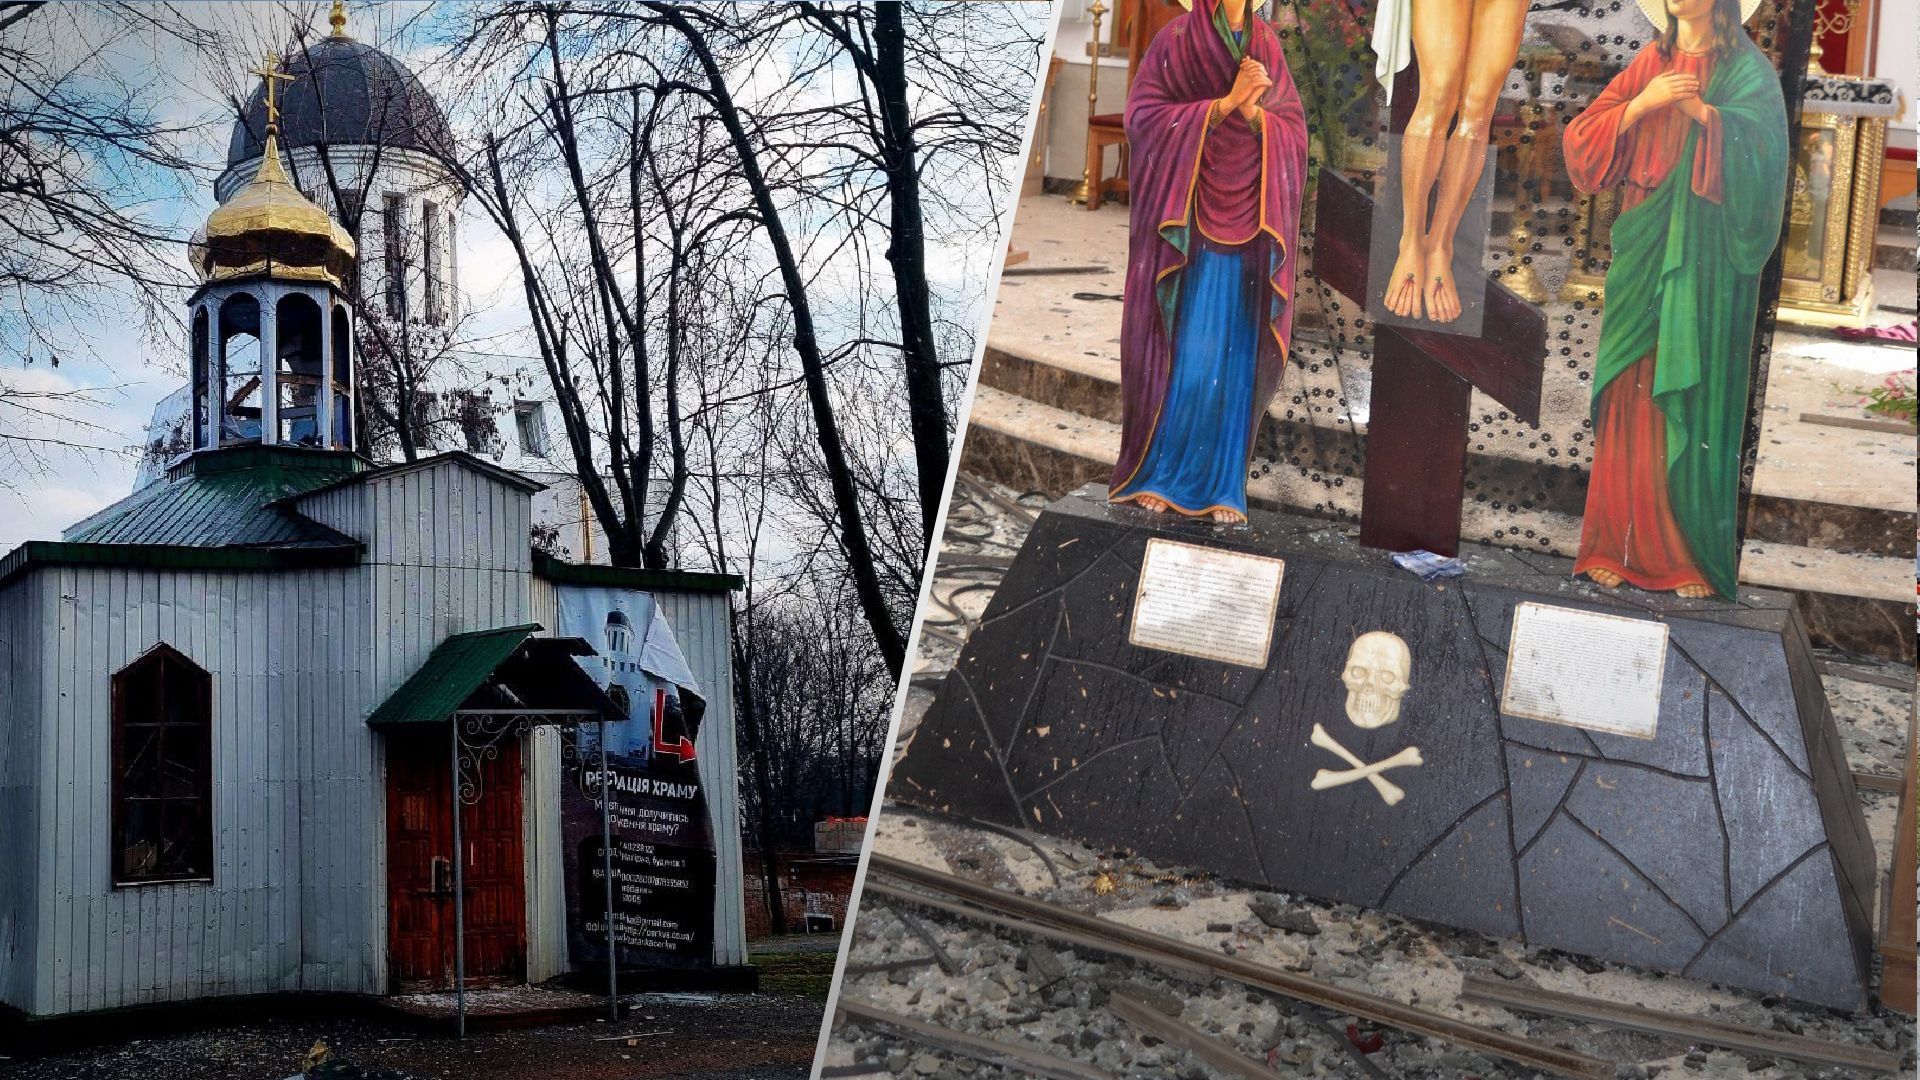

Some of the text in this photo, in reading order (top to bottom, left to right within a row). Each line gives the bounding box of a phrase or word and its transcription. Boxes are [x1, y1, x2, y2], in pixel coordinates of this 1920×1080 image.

[652, 779, 698, 799] ХРАМУ
[638, 808, 689, 823] долучитись
[647, 823, 680, 836] храму?
